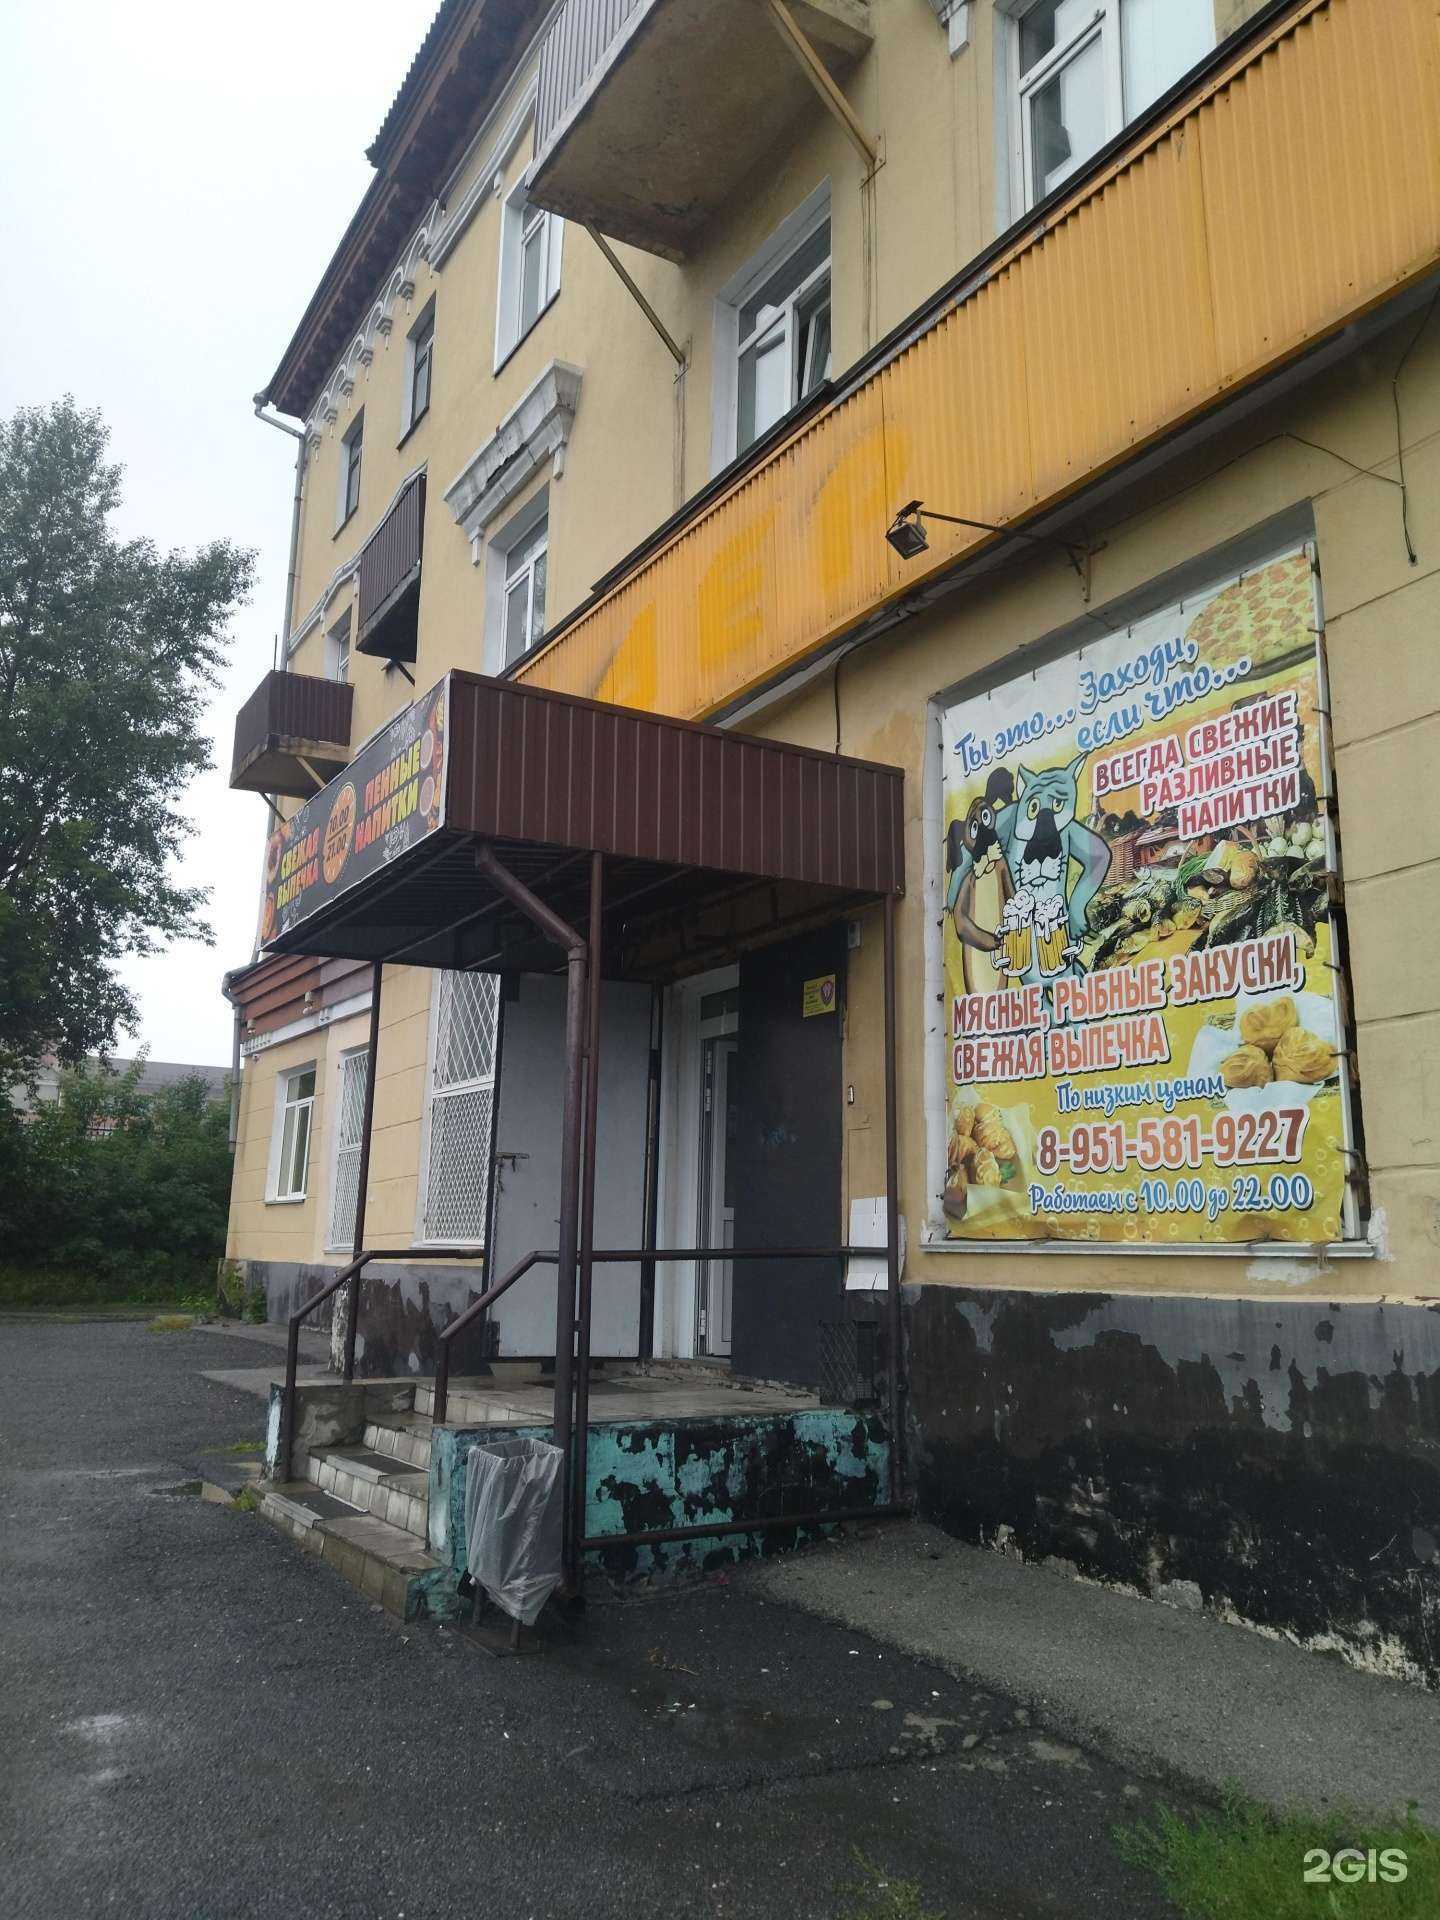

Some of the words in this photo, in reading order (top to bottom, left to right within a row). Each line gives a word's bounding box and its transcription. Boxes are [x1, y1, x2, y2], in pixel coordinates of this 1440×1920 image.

[954, 732, 989, 775] Ты
[994, 711, 1076, 755] это...
[1080, 637, 1197, 711] Заходи,
[1078, 709, 1140, 749] если
[1144, 660, 1250, 714] что...
[364, 738, 421, 813] ПЕННЫЕ
[1096, 738, 1180, 792] ВСЕГДА
[1188, 694, 1295, 758] СВЕЖИЕ
[1143, 735, 1295, 811] РАЗЛИВНЫЕ
[355, 777, 419, 854] НАПИТКИ
[1181, 773, 1296, 837] НАПИТКИ
[277, 858, 319, 909] ВЫПЕЧКА
[281, 827, 320, 880] СВЕЖАЯ
[953, 986, 1048, 1034] МЯСНЫЕ,
[1055, 963, 1162, 1020] РЫБНЫЕ
[1170, 935, 1300, 1001] ЗАКУСКИ,
[953, 1035, 1043, 1080] СВЕЖАЯ
[1053, 1017, 1166, 1072] ВЫПЕЧКА
[1057, 1083, 1080, 1112] По
[1085, 1085, 1152, 1115] низким
[1156, 1076, 1226, 1111] ценам
[1038, 1109, 1306, 1173] 8-951-581-9227
[1030, 1184, 1122, 1213] Работаем
[1126, 1193, 1137, 1211] с
[1141, 1179, 1205, 1211] 10.00
[1209, 1189, 1229, 1219] до
[1233, 1176, 1312, 1211] 22.00
